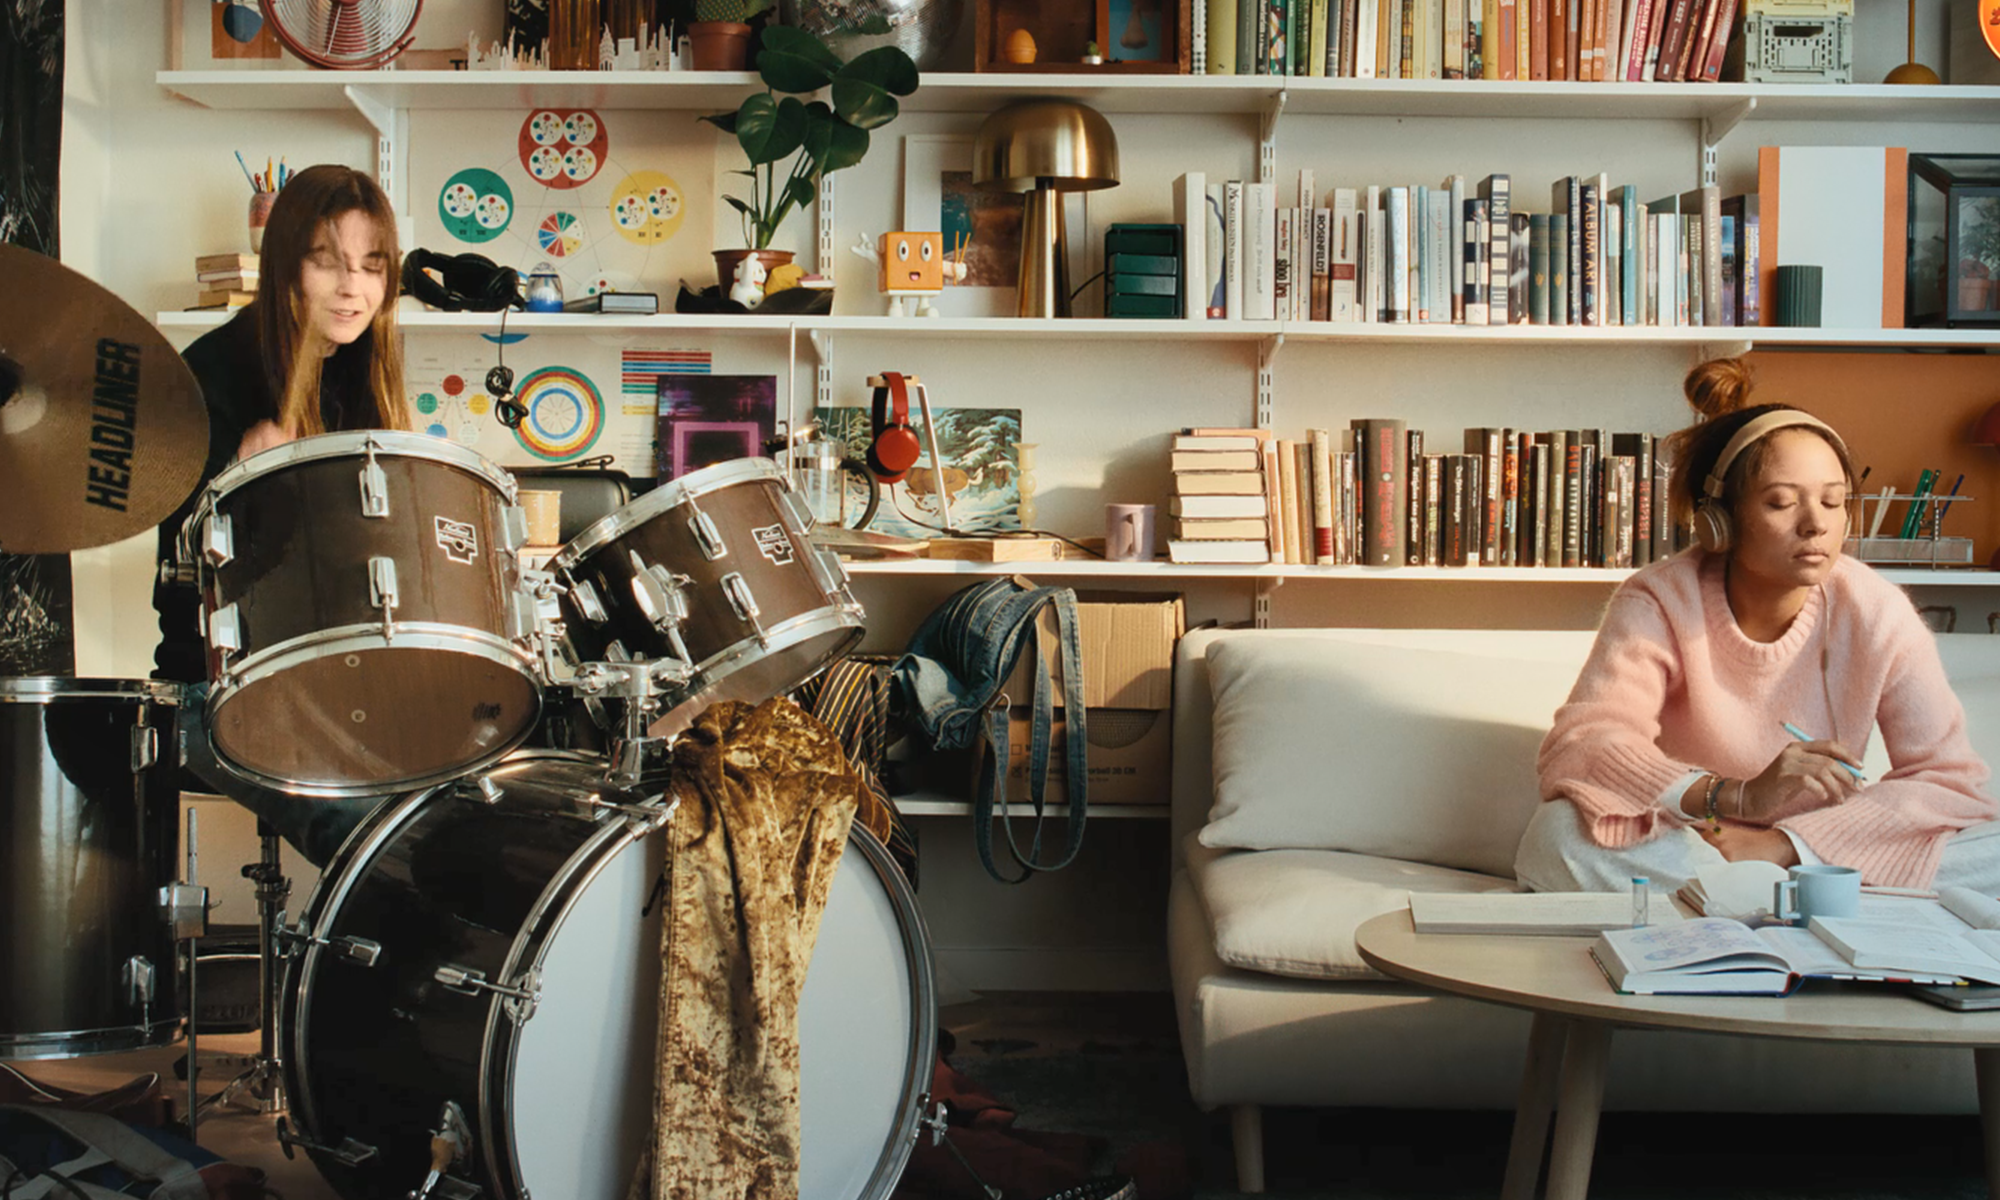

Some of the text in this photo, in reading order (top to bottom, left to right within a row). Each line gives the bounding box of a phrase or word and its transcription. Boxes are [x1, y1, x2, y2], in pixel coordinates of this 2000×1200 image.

[1315, 214, 1326, 274] ROSENFELDT
[1585, 203, 1596, 254] ALBUM
[1585, 260, 1596, 286] ART
[86, 337, 141, 512] HEADLINER
[1568, 445, 1580, 544] DAHL MITTVATTEN
